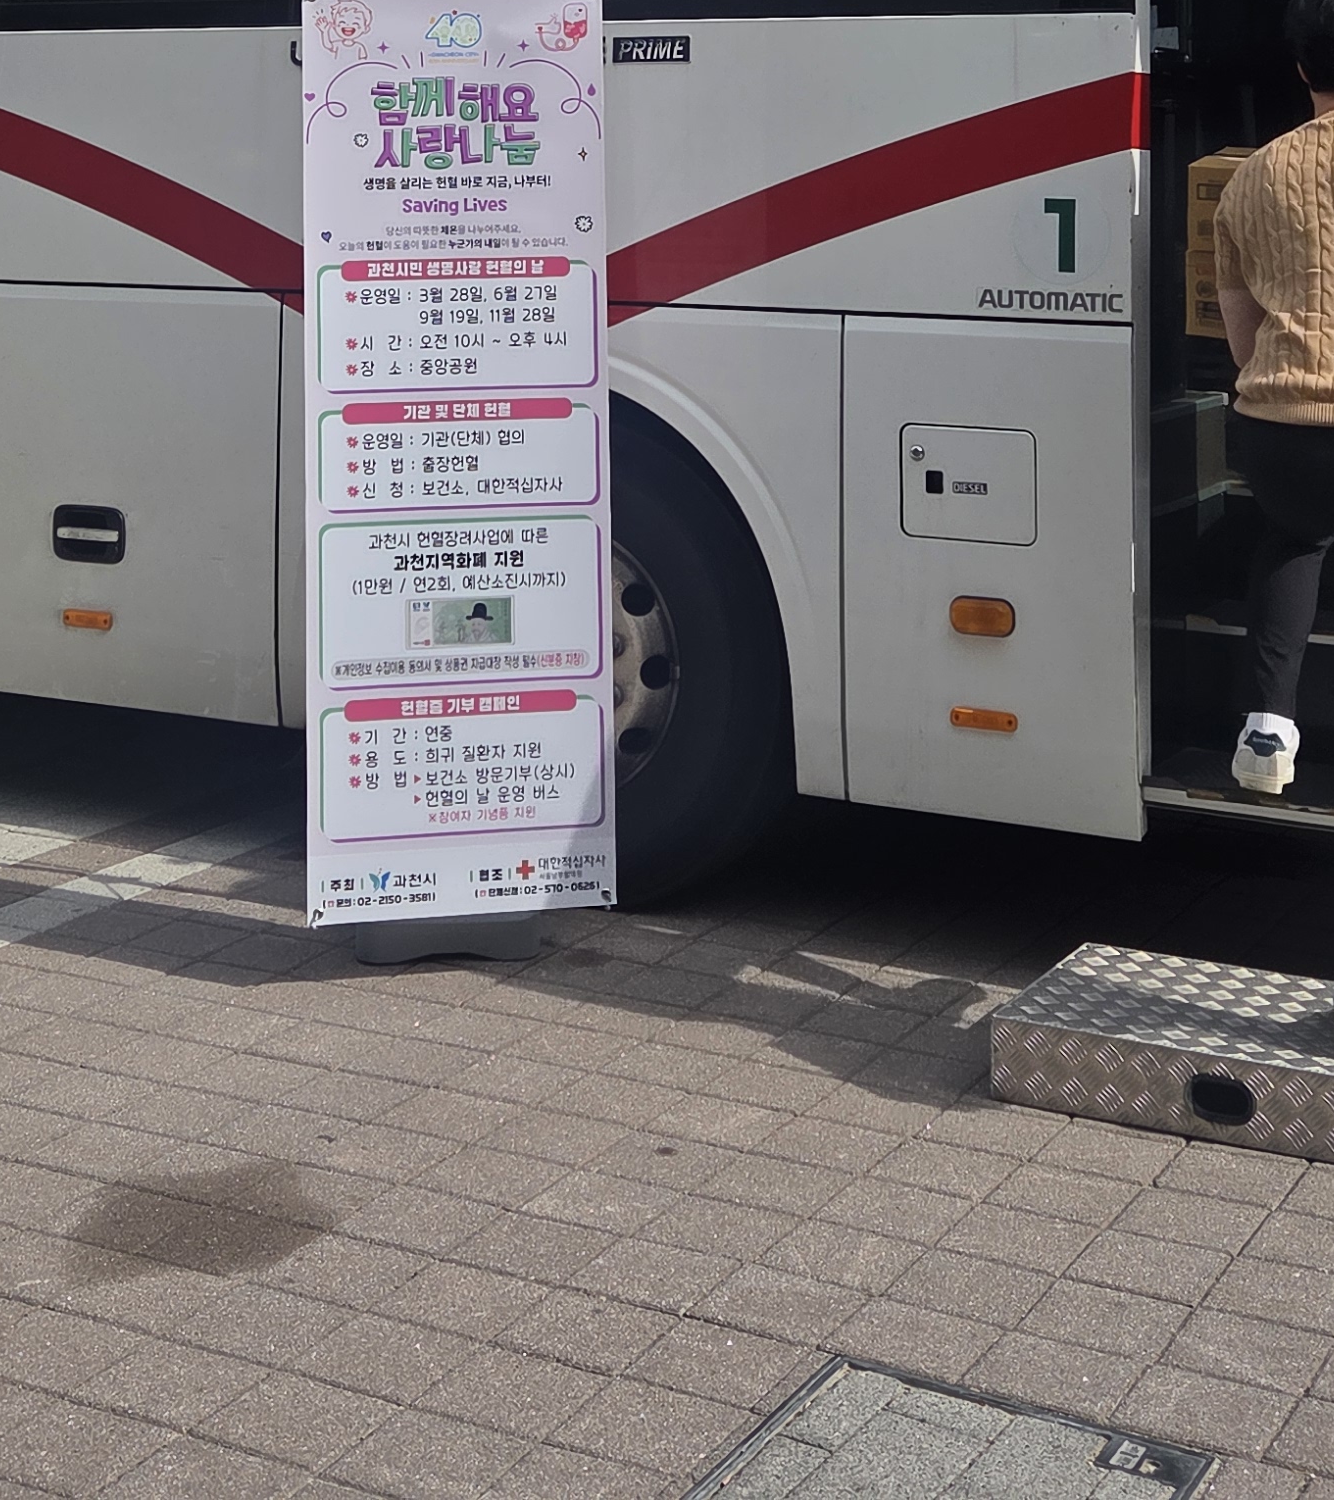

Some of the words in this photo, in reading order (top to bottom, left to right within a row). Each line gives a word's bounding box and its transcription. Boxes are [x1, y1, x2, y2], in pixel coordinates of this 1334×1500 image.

[425, 13, 482, 48] 40
[618, 38, 686, 60] PRIME
[374, 124, 540, 169] 사랑나눔
[363, 178, 396, 190] 생명을
[400, 177, 433, 189] 살리는
[436, 176, 458, 188] 헌혈
[461, 176, 482, 188] 바로
[486, 176, 511, 189] 지금,
[514, 174, 551, 188] 나부터!
[402, 199, 459, 216] Saving
[464, 198, 508, 212] Lives
[385, 225, 411, 236] 당신의
[1044, 198, 1076, 273] 1
[367, 261, 423, 277] 과천시민
[427, 260, 481, 276] 생명사랑
[486, 260, 527, 275] 헌혈의
[531, 259, 544, 274] 날
[360, 288, 401, 306] 운영일
[419, 288, 443, 303] 3월
[450, 287, 487, 303] 28일,
[494, 287, 517, 302] 6월
[524, 285, 557, 301] 27일
[978, 288, 1124, 313] AUTOMATIC
[419, 310, 443, 326] 9월
[450, 308, 484, 325] 19일,
[489, 308, 515, 324] 11월
[522, 307, 555, 323] 28일
[419, 335, 447, 350] 오전
[454, 333, 485, 349] 10시
[509, 332, 536, 347] 오후
[544, 331, 567, 347] 4시
[420, 358, 478, 376] 중앙공원
[403, 404, 431, 420] 기관
[435, 404, 449, 419] 및
[453, 403, 480, 419] 단체
[484, 402, 511, 418] 헌혈
[362, 432, 403, 450] 운영일
[421, 430, 491, 448] 기관(단체)
[497, 429, 525, 445] 협의
[422, 455, 479, 473] 출장헌혈
[422, 480, 469, 496] 보건소,
[477, 477, 563, 494] 대한적십자사
[953, 482, 986, 494] DIESEL
[369, 532, 410, 550] 과천시
[417, 529, 514, 548] 헌혈장려사업에
[522, 528, 548, 545] 따른
[394, 552, 487, 571] 과천지역화폐
[494, 550, 524, 569] 지원
[352, 578, 392, 596] (1만원
[414, 576, 456, 594] 연2회,
[462, 571, 566, 591] 예산소진시까지)
[401, 700, 443, 716] 헌혈증
[447, 698, 474, 714] 기부
[479, 695, 520, 712] 캠페인
[425, 725, 452, 742] 연중
[425, 748, 454, 764] 희귀
[462, 744, 505, 762] 질환자
[513, 742, 541, 759] 지원
[425, 770, 467, 787] 보건소
[476, 763, 575, 784] 방문기부(상시)
[425, 790, 468, 807] 헌혈의
[476, 788, 490, 804] 날
[497, 786, 525, 803] 운영
[533, 784, 560, 800] 버스
[477, 807, 508, 821] 기념품
[514, 806, 536, 819] 지원
[479, 868, 503, 882] 협조
[538, 854, 606, 870] 대한적십자사
[393, 872, 436, 888] 과천시
